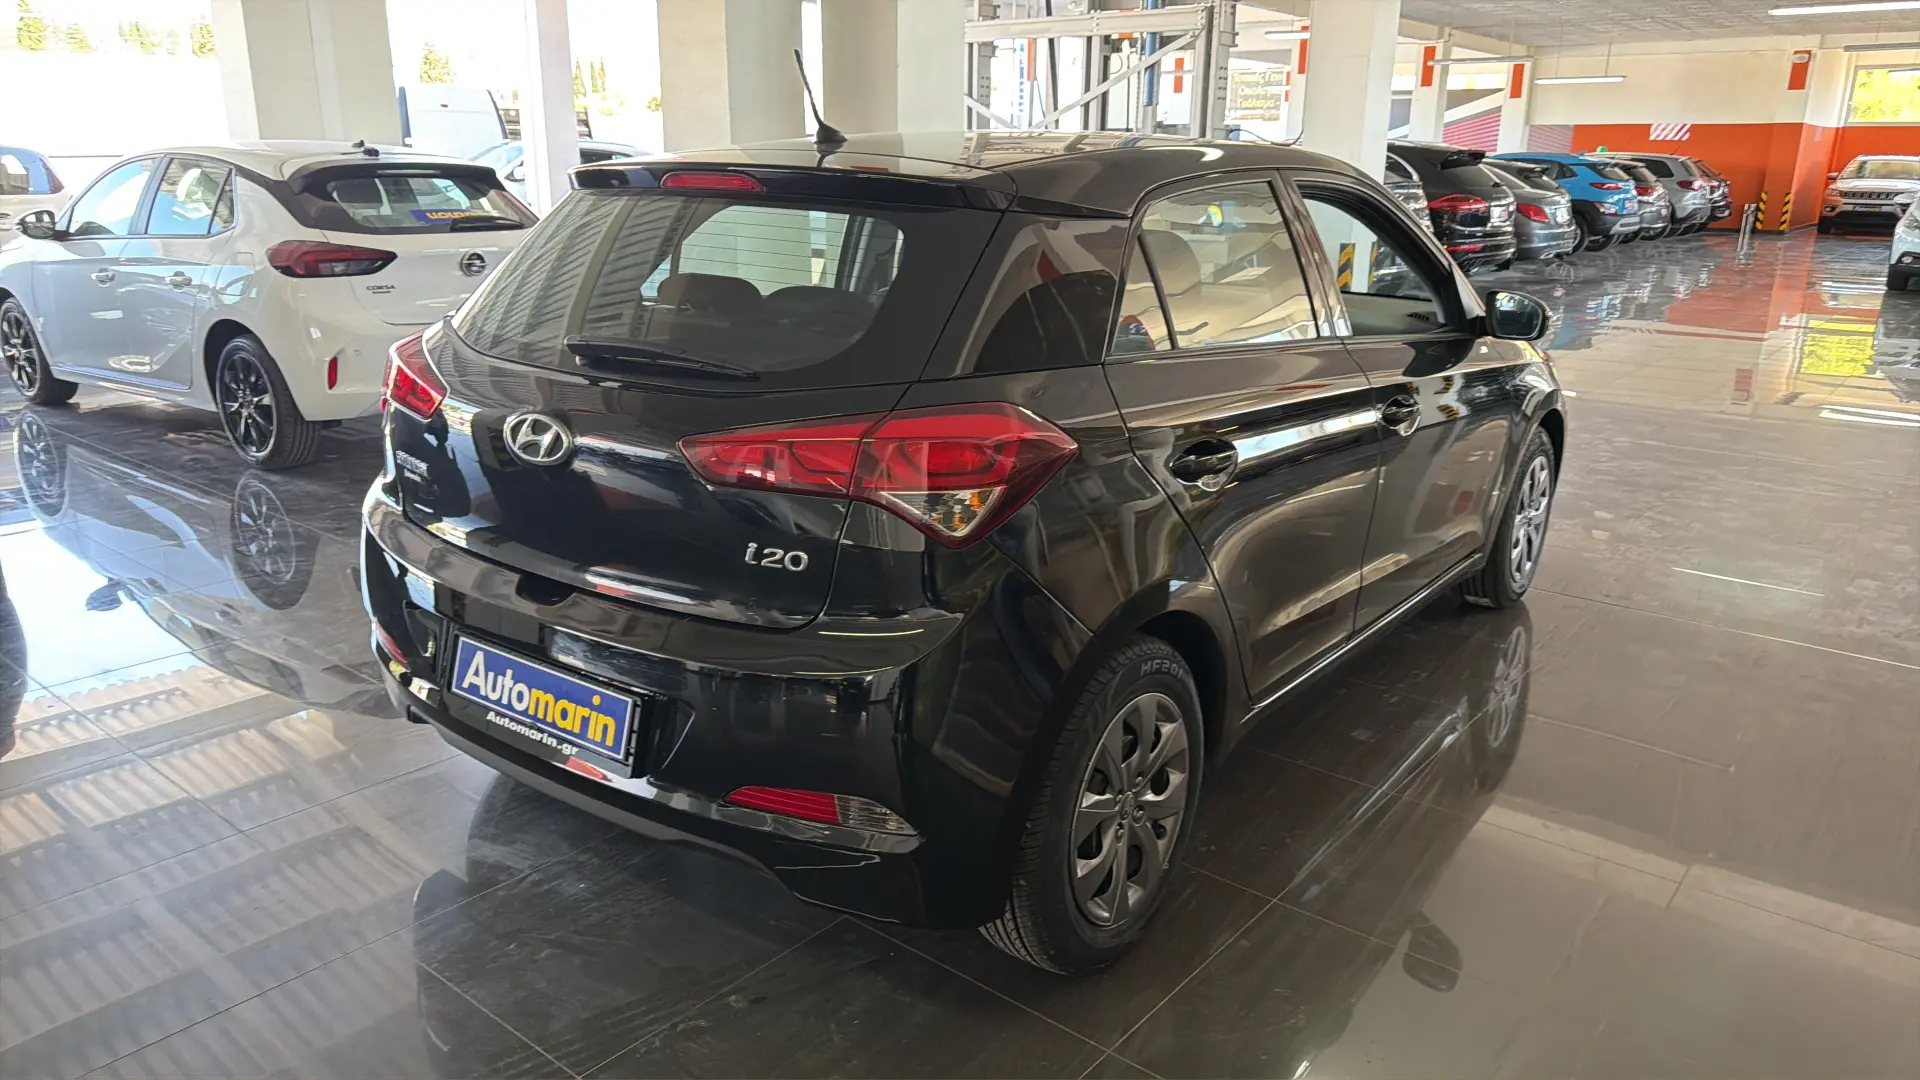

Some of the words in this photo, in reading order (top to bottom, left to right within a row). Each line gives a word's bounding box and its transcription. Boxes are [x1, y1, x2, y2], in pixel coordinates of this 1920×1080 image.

[745, 542, 809, 572] i20
[461, 650, 616, 747] Automarin
[486, 711, 579, 756] Automarin.gr
